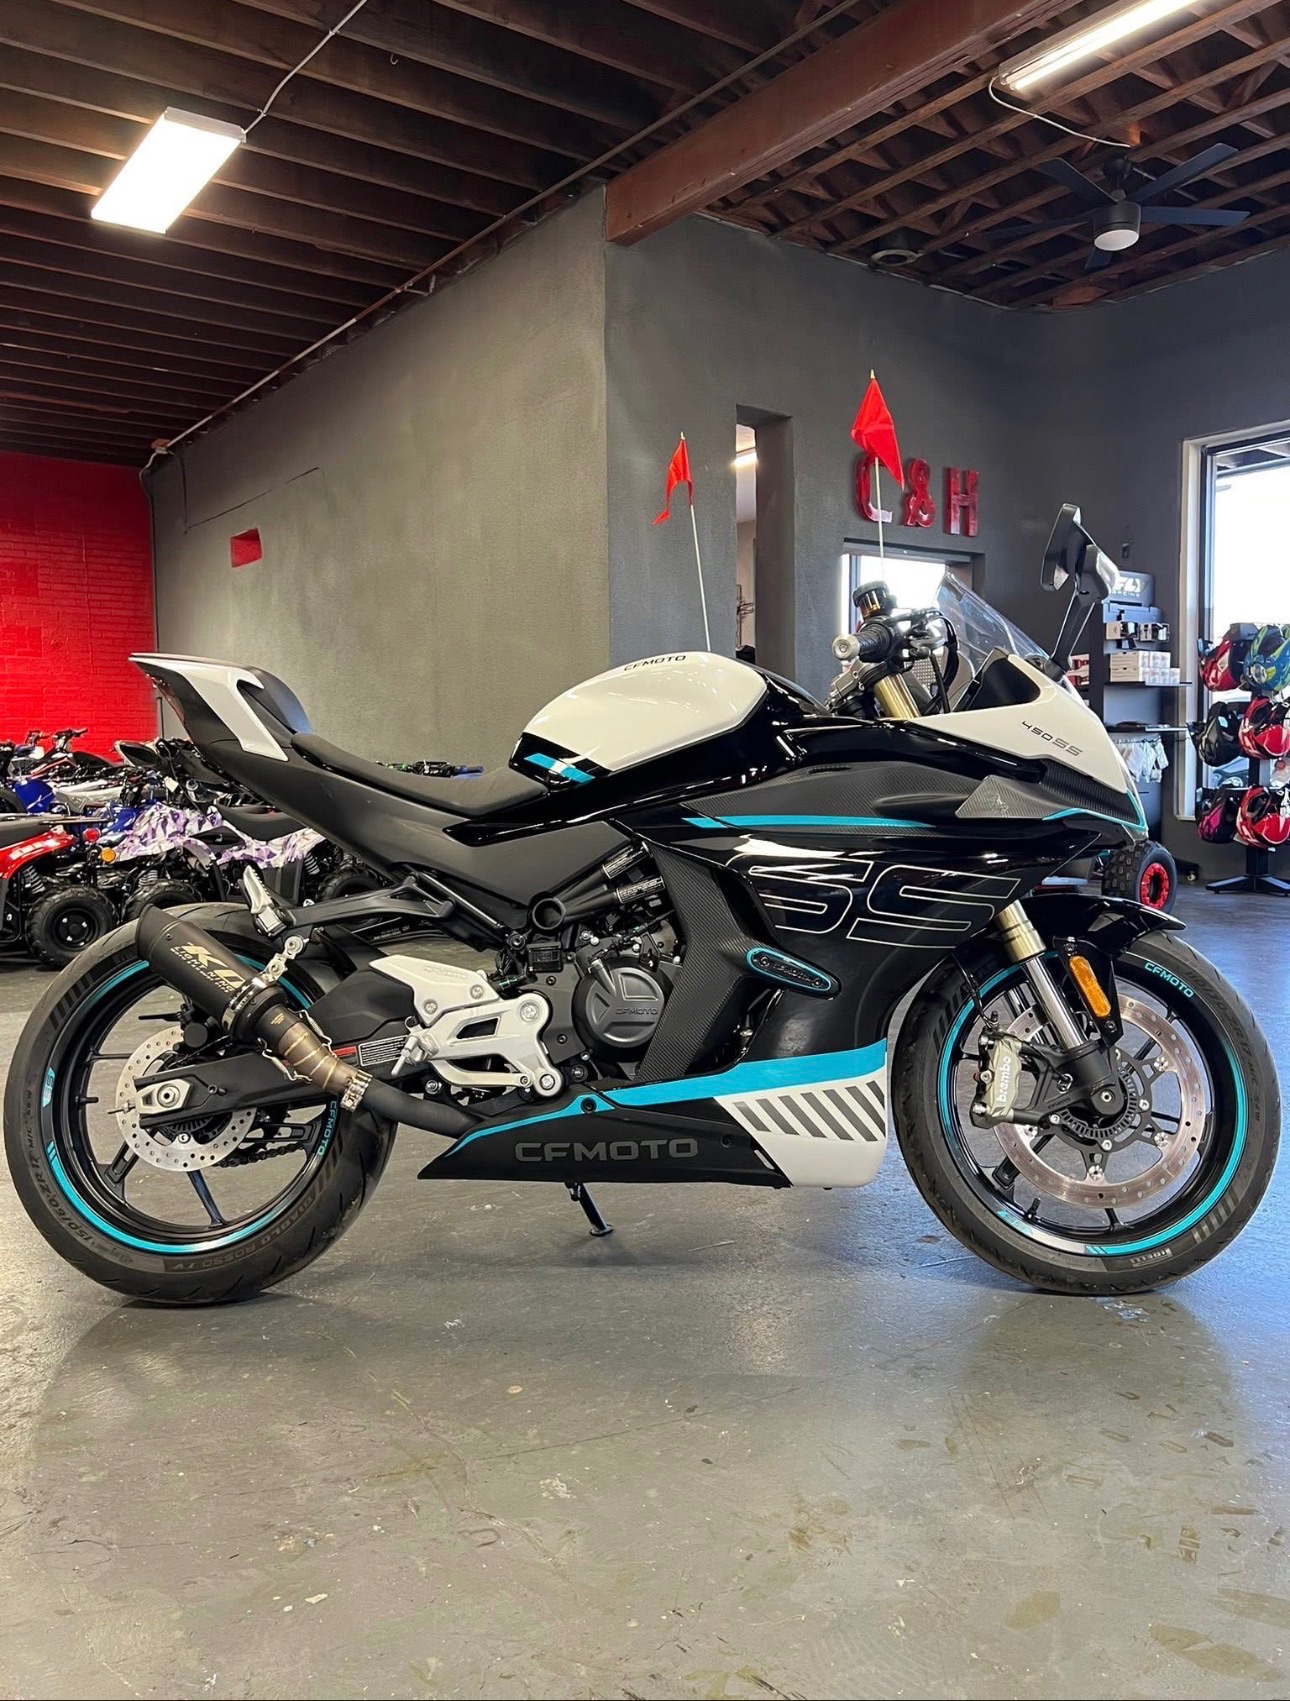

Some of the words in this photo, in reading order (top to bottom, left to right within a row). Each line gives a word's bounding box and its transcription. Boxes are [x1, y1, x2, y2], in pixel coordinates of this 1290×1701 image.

[623, 655, 686, 671] CFMOTO
[1144, 961, 1195, 998] CFMOTO
[615, 1008, 659, 1016] CFMOTO
[996, 1055, 1012, 1103] brembo
[317, 1100, 338, 1157] CFMOTO
[514, 1138, 699, 1162] CFMOTO
